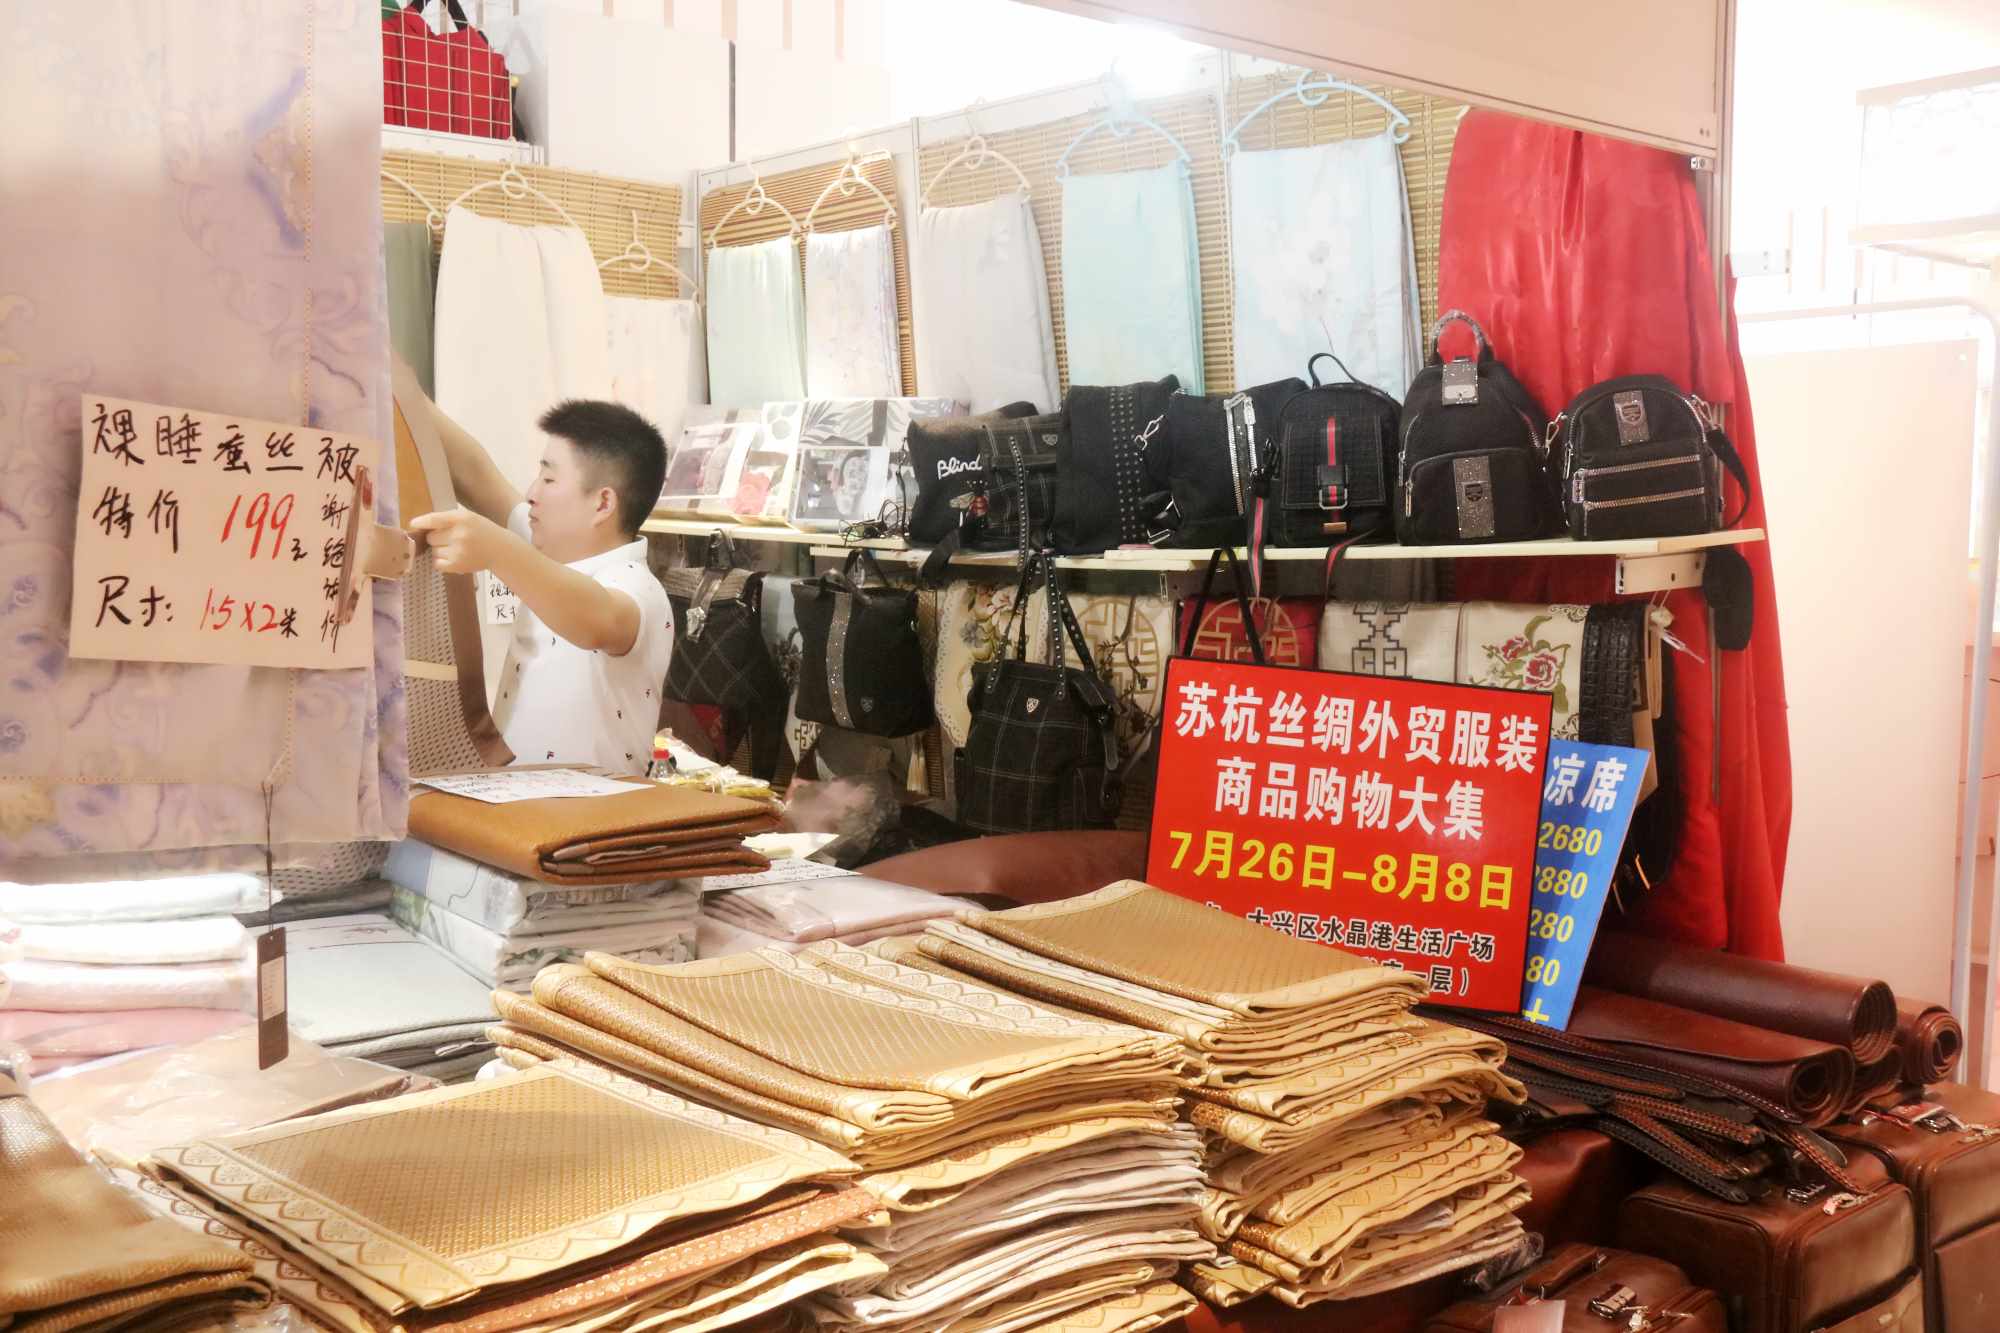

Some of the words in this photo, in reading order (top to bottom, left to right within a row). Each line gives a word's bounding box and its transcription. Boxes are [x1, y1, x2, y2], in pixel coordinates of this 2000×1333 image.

[92, 486, 180, 554] 特价
[1174, 680, 1539, 774] 苏杭丝绸外贸服装
[1215, 755, 1485, 841] 商品购物大集
[1543, 752, 1628, 814] 凉席
[1168, 829, 1514, 910] 7月26日-8月8日
[1538, 821, 1603, 857] 2680
[1535, 863, 1589, 900] 880
